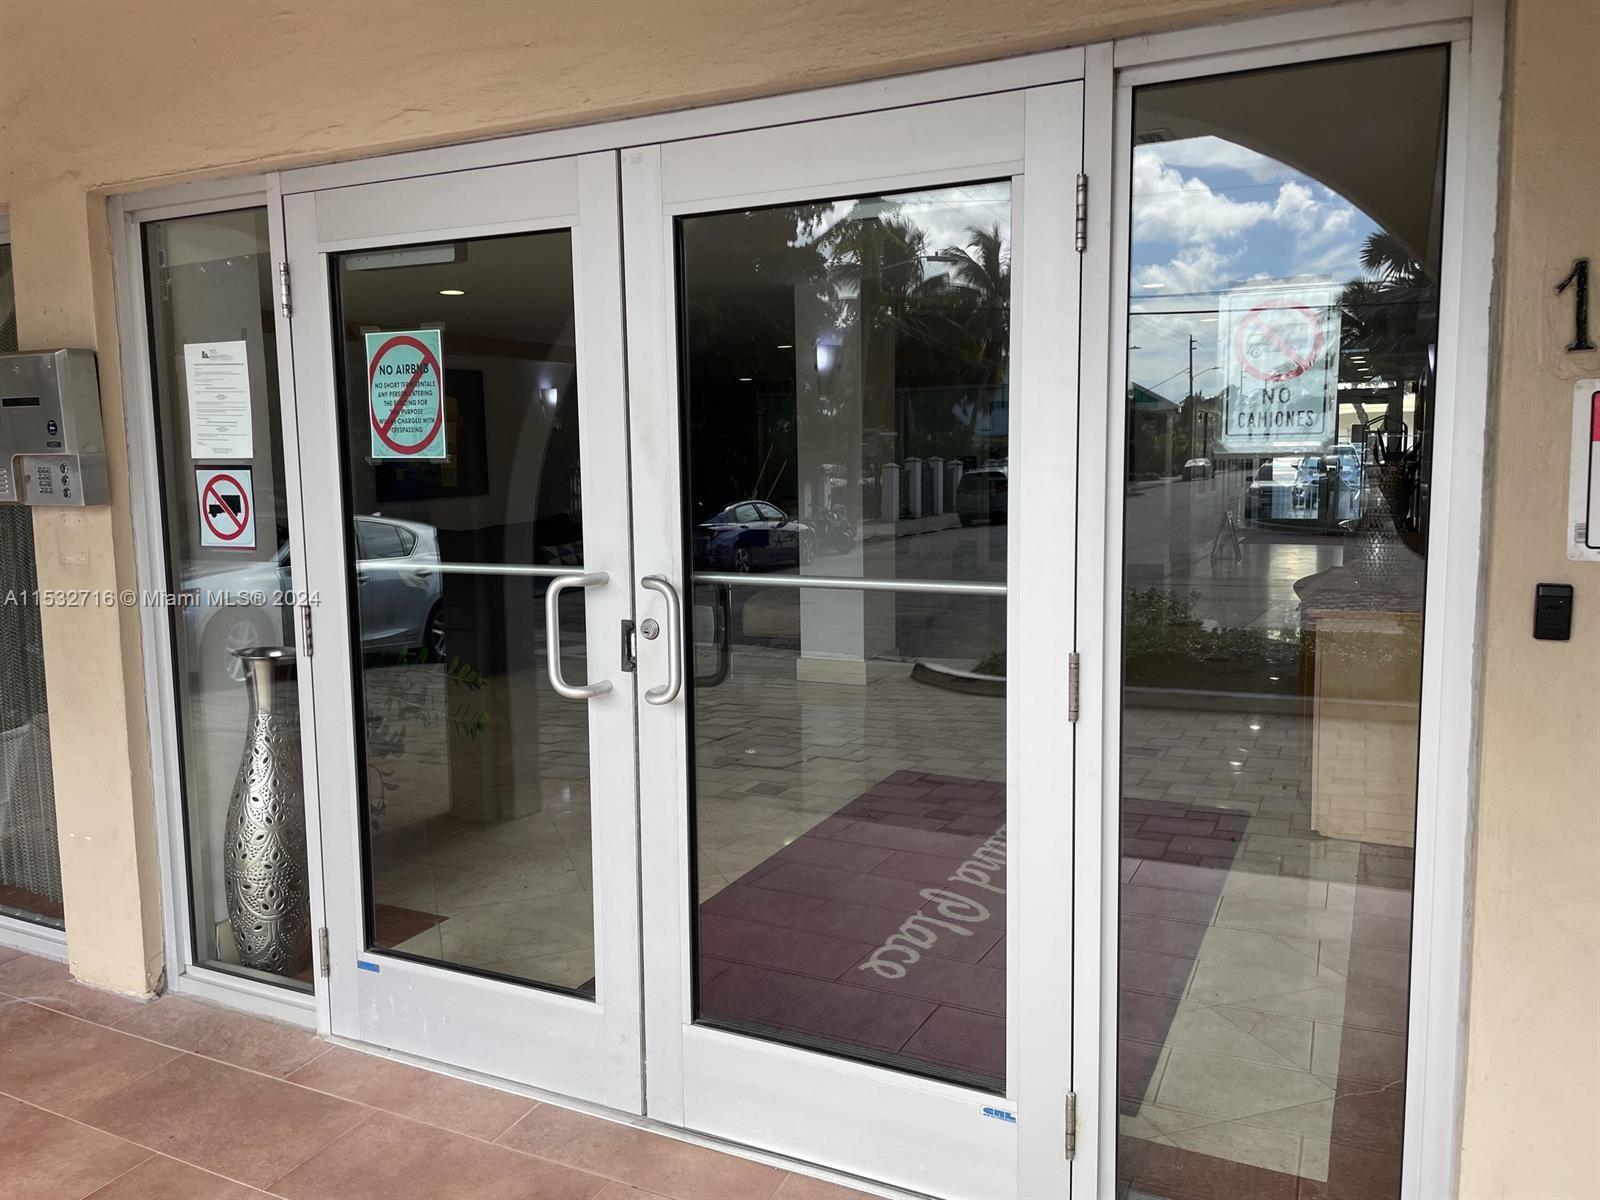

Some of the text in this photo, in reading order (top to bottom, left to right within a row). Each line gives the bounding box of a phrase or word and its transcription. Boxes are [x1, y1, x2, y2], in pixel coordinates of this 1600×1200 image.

[1556, 258, 1596, 351] 1
[379, 363, 429, 375] NO AIRBNB
[1262, 387, 1291, 405] NO
[1238, 410, 1314, 429] CAMIONES
